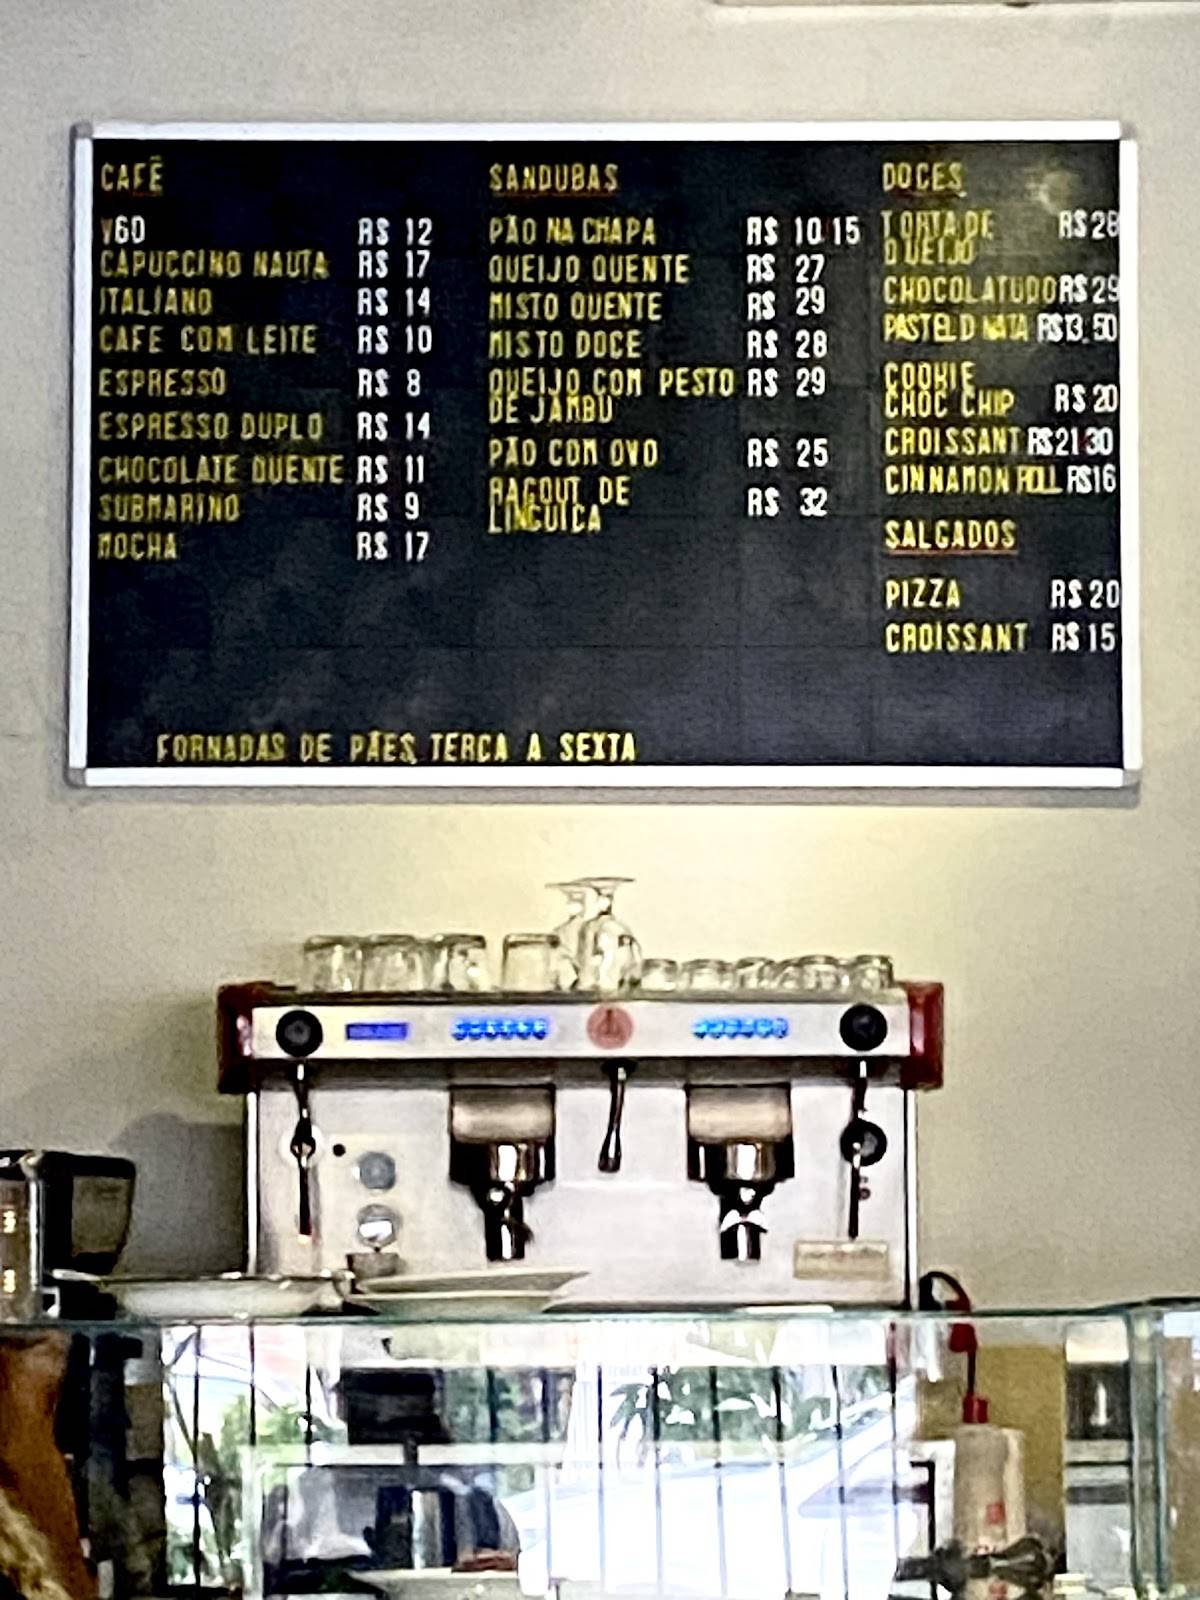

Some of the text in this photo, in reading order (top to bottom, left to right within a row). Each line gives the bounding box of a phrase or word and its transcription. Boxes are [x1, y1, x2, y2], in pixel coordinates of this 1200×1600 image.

[489, 162, 619, 193] SANDUBAS
[882, 162, 963, 191] DOCES
[101, 215, 145, 245] V60
[405, 217, 433, 246] 12
[489, 214, 656, 245] PÃO NA CHAPA
[881, 210, 993, 238] TORTA DE
[99, 249, 331, 279] CAPUCCINO NAUTA
[405, 249, 431, 279] 17
[489, 255, 690, 283] QUEIJO QUENTE
[795, 254, 826, 283] 27
[99, 287, 213, 316] ITALIANO
[405, 288, 431, 317] 14
[795, 286, 826, 316] 29
[883, 275, 1056, 305] CHOCOLATUDO
[1092, 276, 1119, 304] 29
[489, 292, 663, 321] MISTO QUENTE
[99, 324, 318, 354] CAFE COM LEITE
[405, 325, 432, 354] 10
[884, 313, 956, 342] PASTEL
[489, 330, 642, 359] MISTO DOCE
[795, 330, 828, 359] 28
[99, 368, 227, 397] ESPRESSO
[406, 369, 421, 396] 8
[489, 368, 735, 397] QUEIJO COM PESTO
[795, 368, 826, 397] 29
[884, 361, 976, 390] COOKIE
[489, 395, 614, 424] DE JAMBU
[885, 389, 948, 418] CHOC
[1093, 384, 1119, 413] 20
[99, 411, 323, 441] ESPRESSO DUPLO
[406, 412, 431, 441] 14
[489, 436, 658, 467] PÃO COM OVO
[796, 438, 829, 467] 25
[885, 427, 1021, 456] CROISSANT
[99, 454, 344, 484] CHOCOLATE QUENTE
[405, 456, 424, 484] 11
[885, 464, 1062, 494] CINNAMON ROLL
[599, 476, 631, 506] DE
[799, 487, 827, 517] 32
[99, 493, 240, 524] SUBMARINO
[404, 493, 419, 521] 9
[98, 532, 178, 560] MOCHA
[405, 531, 430, 561] 17
[885, 520, 1016, 549] SALGADOS
[885, 578, 961, 609] PIZZA
[1090, 580, 1119, 609] 20
[885, 623, 1028, 653] CROISSANT
[1088, 623, 1115, 652] 15
[156, 732, 285, 763] FORNADAS
[299, 733, 332, 762] DE
[429, 732, 508, 762] TERCA
[527, 733, 541, 762] A
[559, 732, 637, 762] SEXTA
